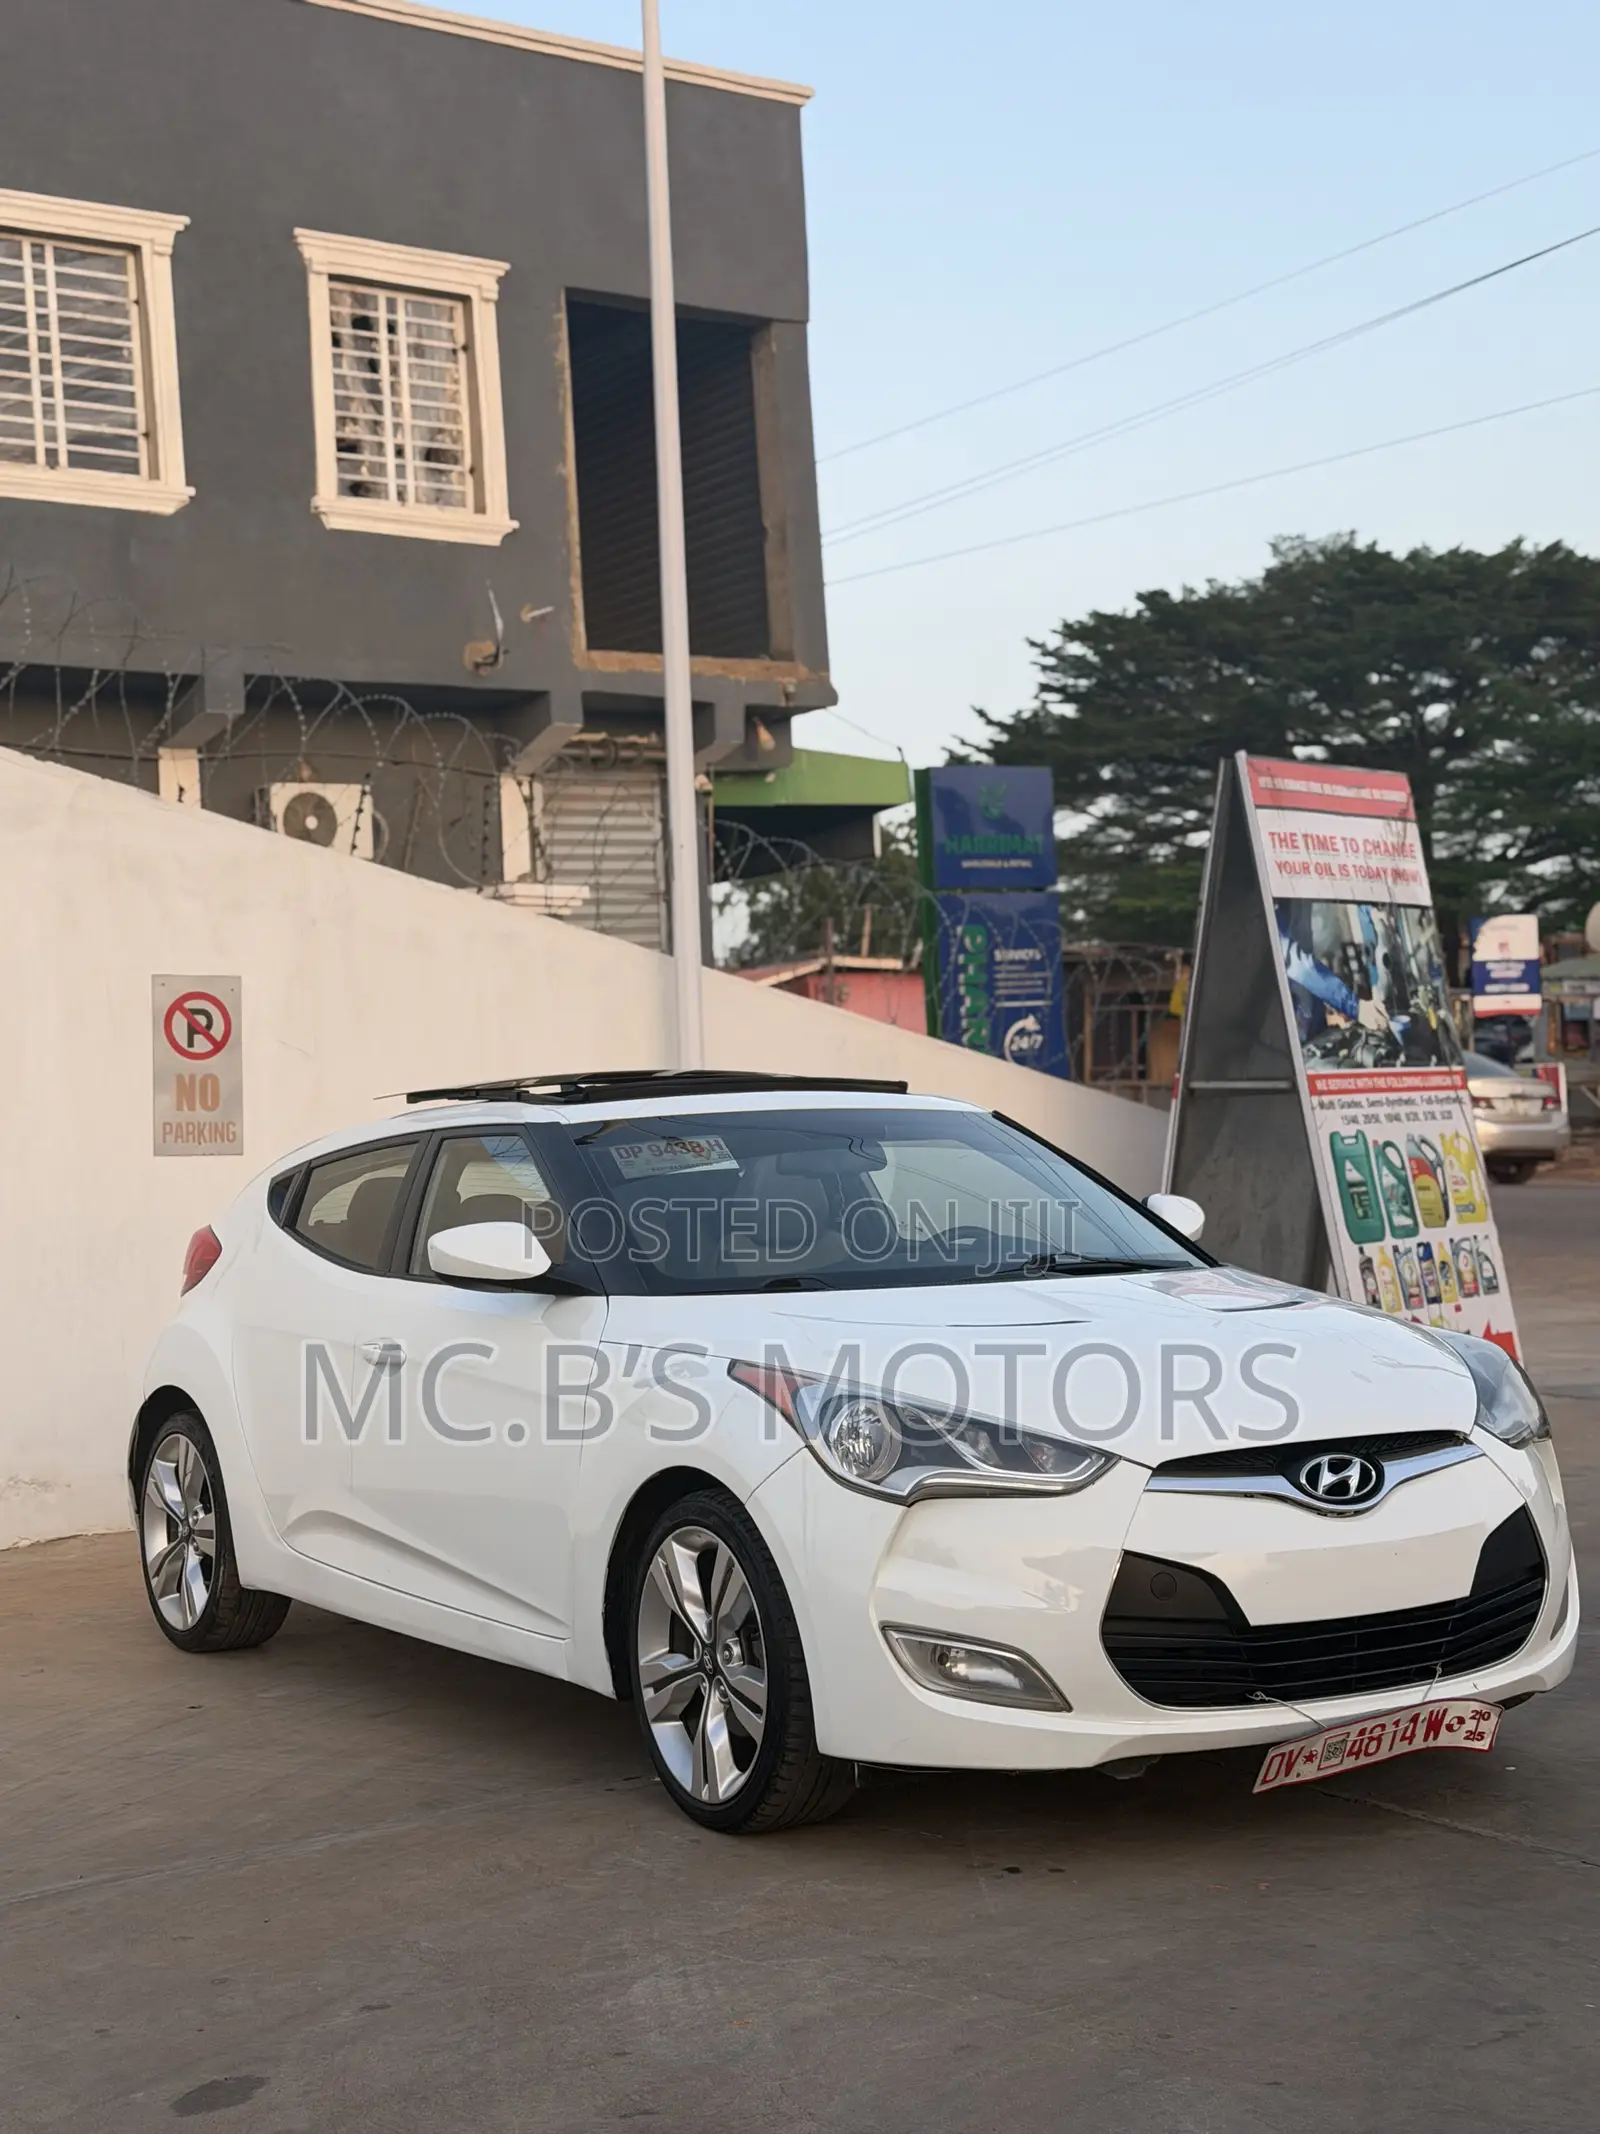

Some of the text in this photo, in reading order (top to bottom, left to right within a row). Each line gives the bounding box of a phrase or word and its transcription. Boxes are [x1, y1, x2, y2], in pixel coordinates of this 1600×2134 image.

[1268, 832, 1416, 860] THE TIME TO CHANGE
[1275, 860, 1311, 876] YOUR
[1314, 862, 1336, 877] OIL
[1338, 864, 1350, 878] IS
[1352, 864, 1388, 880] TODAY
[957, 924, 989, 1052] PHAR
[175, 1073, 220, 1112] NO
[162, 1121, 236, 1144] PARKING
[614, 1145, 643, 1160] DP
[1467, 1708, 1491, 1721] 20
[1463, 1729, 1486, 1742] 25
[1261, 1746, 1305, 1785] DV
